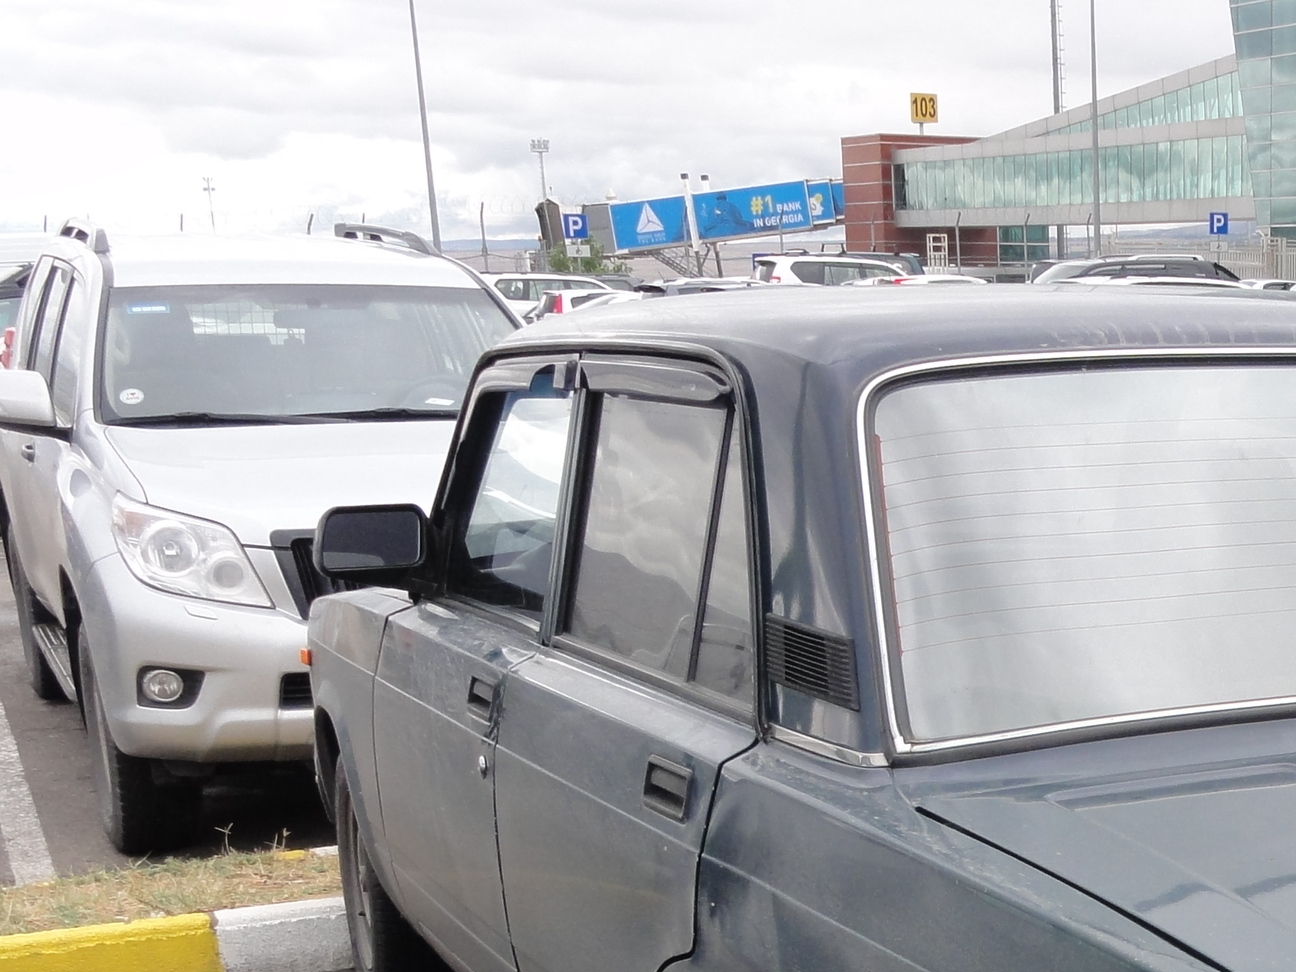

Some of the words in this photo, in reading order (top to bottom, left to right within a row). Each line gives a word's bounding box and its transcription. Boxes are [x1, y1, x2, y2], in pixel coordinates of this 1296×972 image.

[912, 96, 936, 118] 103
[750, 194, 774, 216] #1
[776, 201, 802, 213] BANK
[568, 216, 583, 237] P
[753, 217, 764, 228] IN
[765, 213, 804, 226] GEORGIA
[1213, 214, 1225, 233] P
